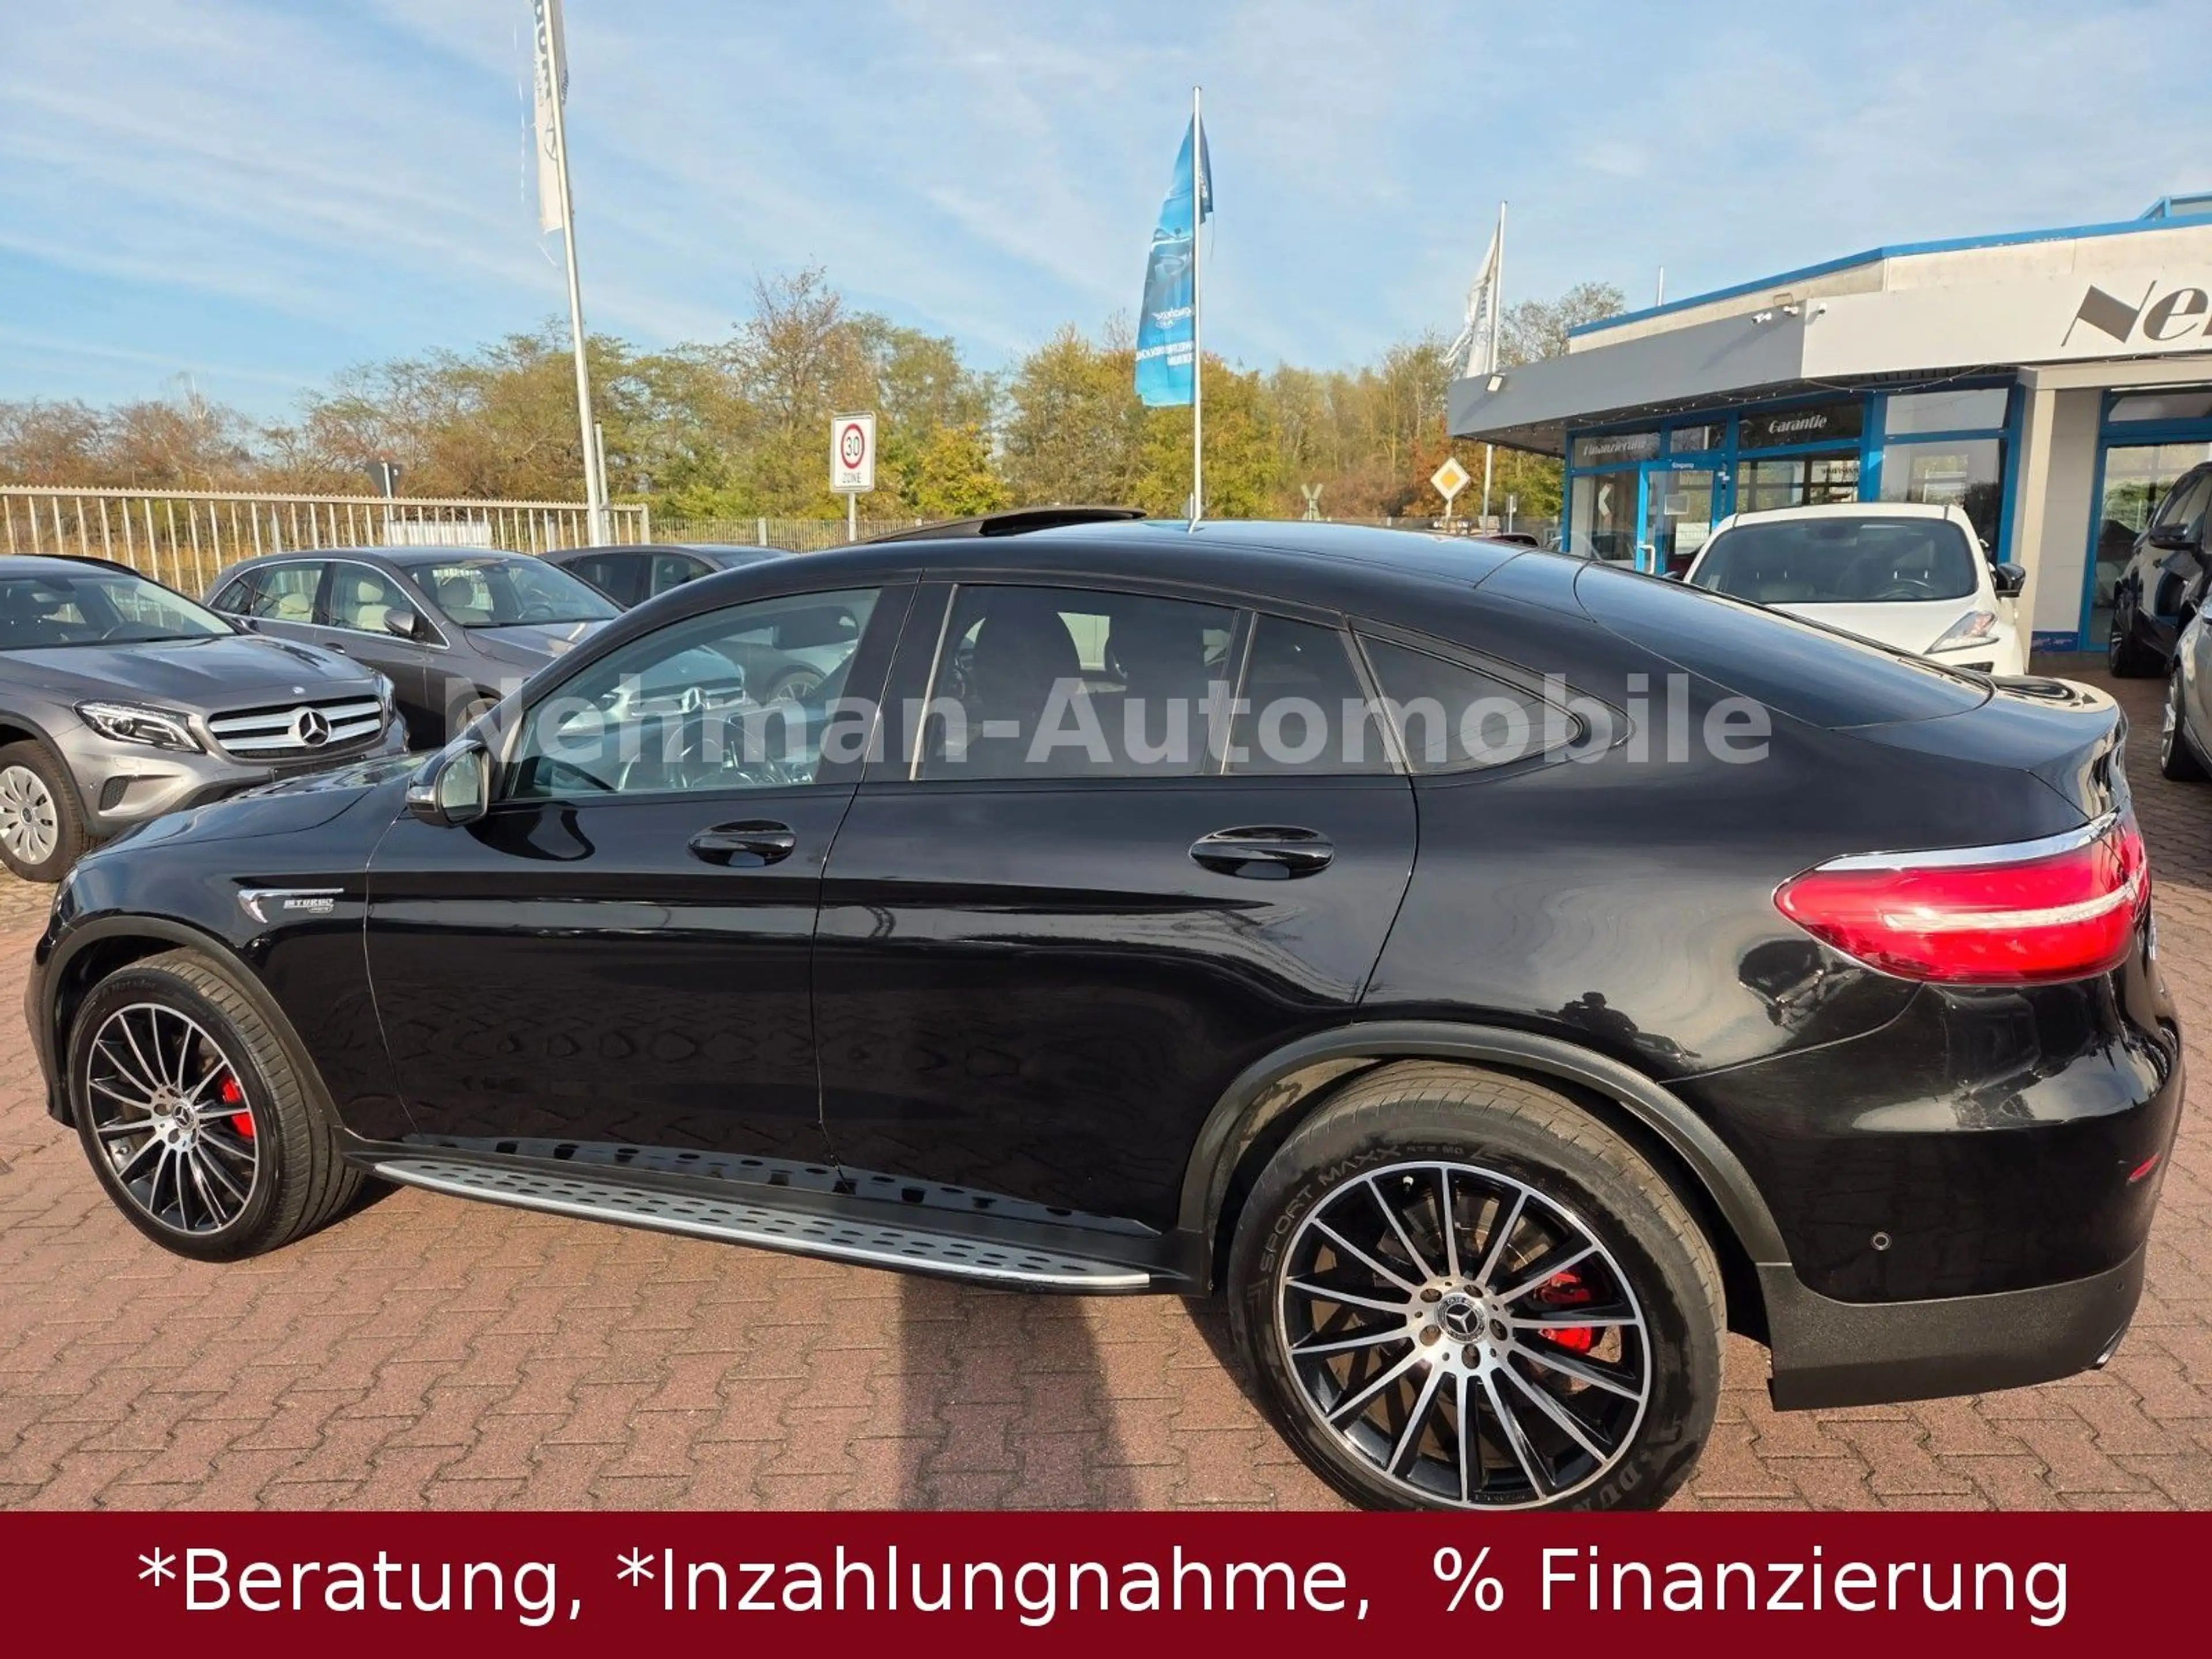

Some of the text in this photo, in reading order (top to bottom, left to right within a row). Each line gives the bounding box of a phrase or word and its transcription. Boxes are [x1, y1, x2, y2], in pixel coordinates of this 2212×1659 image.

[2061, 280, 2212, 347] Ne
[1768, 414, 1828, 433] Garantie
[846, 437, 859, 456] 30
[843, 472, 862, 483] ZONE
[1260, 1184, 1313, 1274] SPORT
[1317, 1145, 1401, 1187] MAXX
